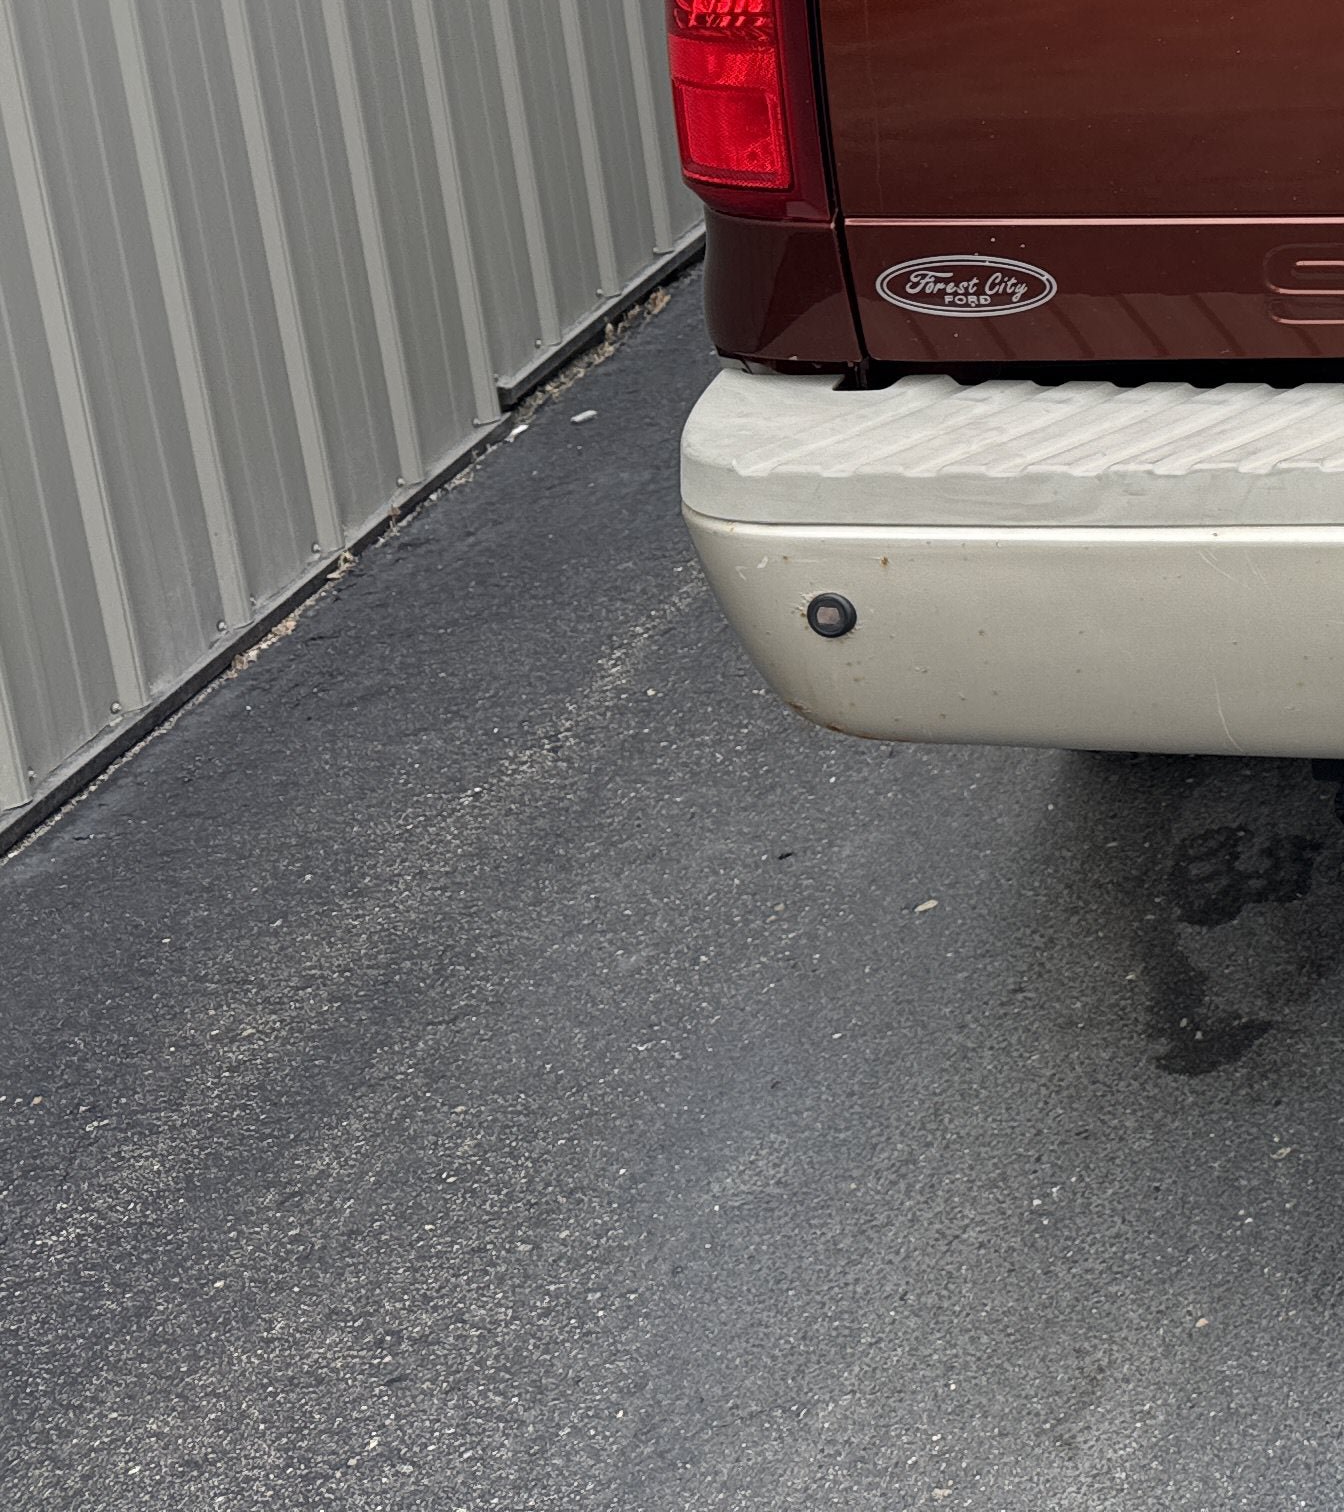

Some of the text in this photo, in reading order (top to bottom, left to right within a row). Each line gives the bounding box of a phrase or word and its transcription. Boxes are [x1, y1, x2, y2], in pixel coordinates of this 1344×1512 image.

[906, 271, 1028, 302] Forest City
[944, 295, 991, 305] FORD
